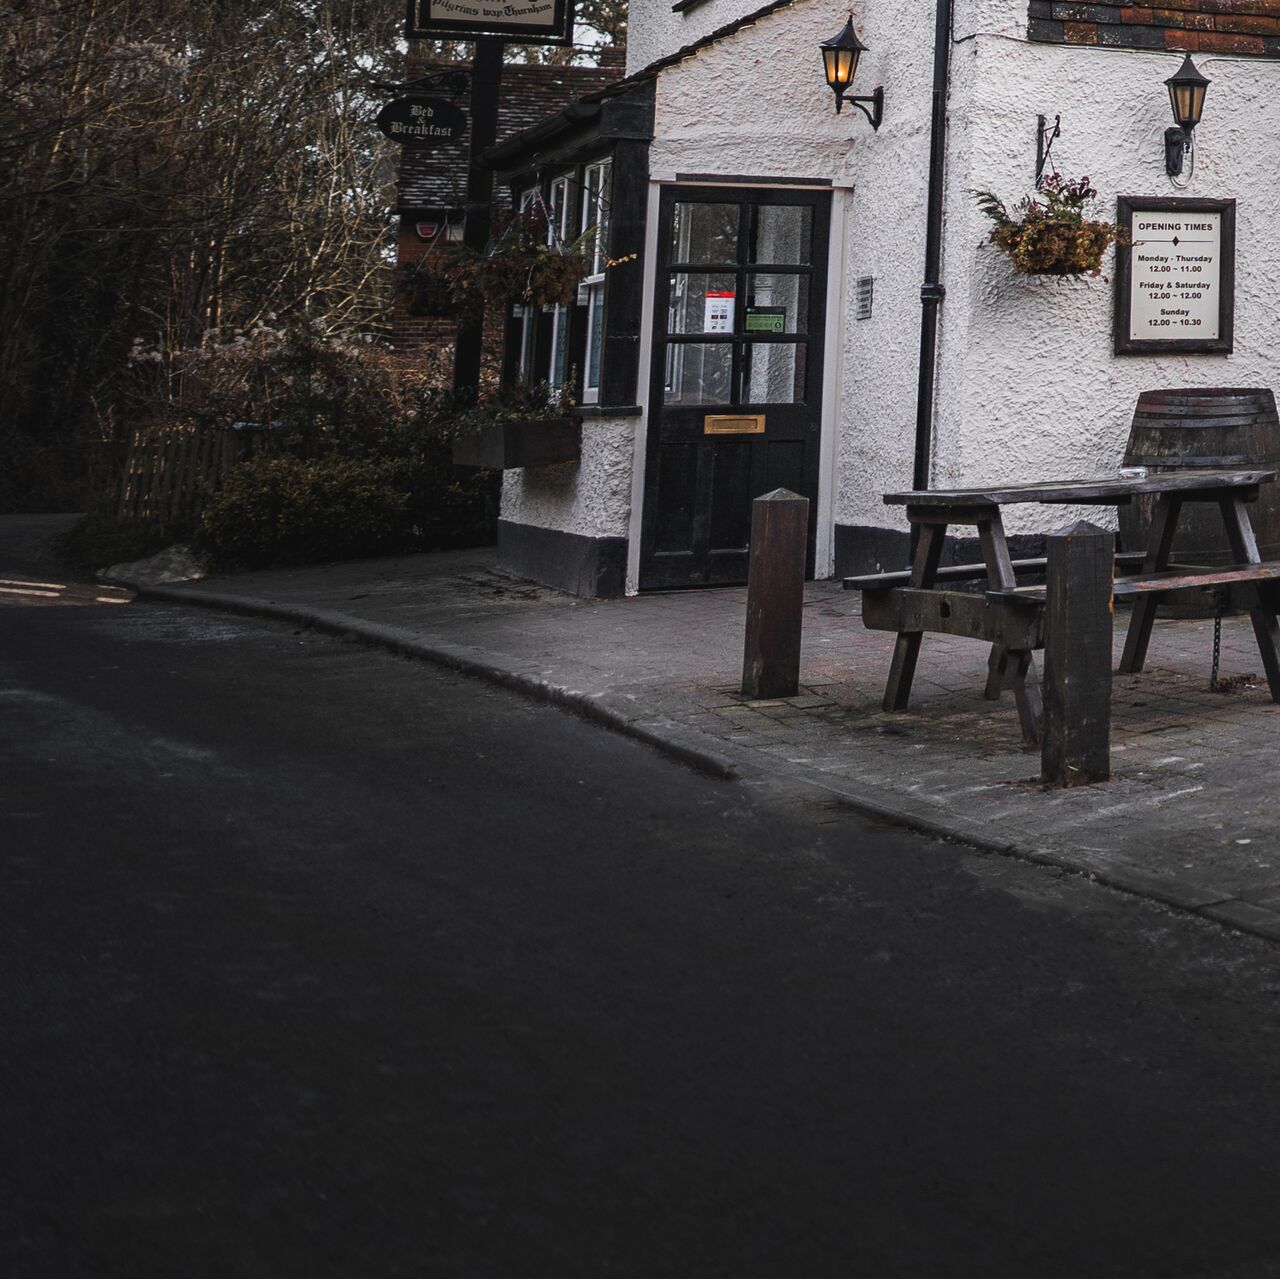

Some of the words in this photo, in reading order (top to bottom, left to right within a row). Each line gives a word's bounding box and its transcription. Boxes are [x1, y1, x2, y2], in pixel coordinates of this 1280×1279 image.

[410, 104, 434, 117] Bed
[390, 121, 453, 136] Breakfast
[1138, 222, 1181, 231] OPENING
[1184, 223, 1213, 231] TIMES
[1138, 255, 1168, 263] Monday
[1176, 255, 1213, 263] Thursday
[1139, 282, 1164, 290] Friday
[1175, 282, 1211, 290] Saturday
[1160, 309, 1190, 317] Sunday
